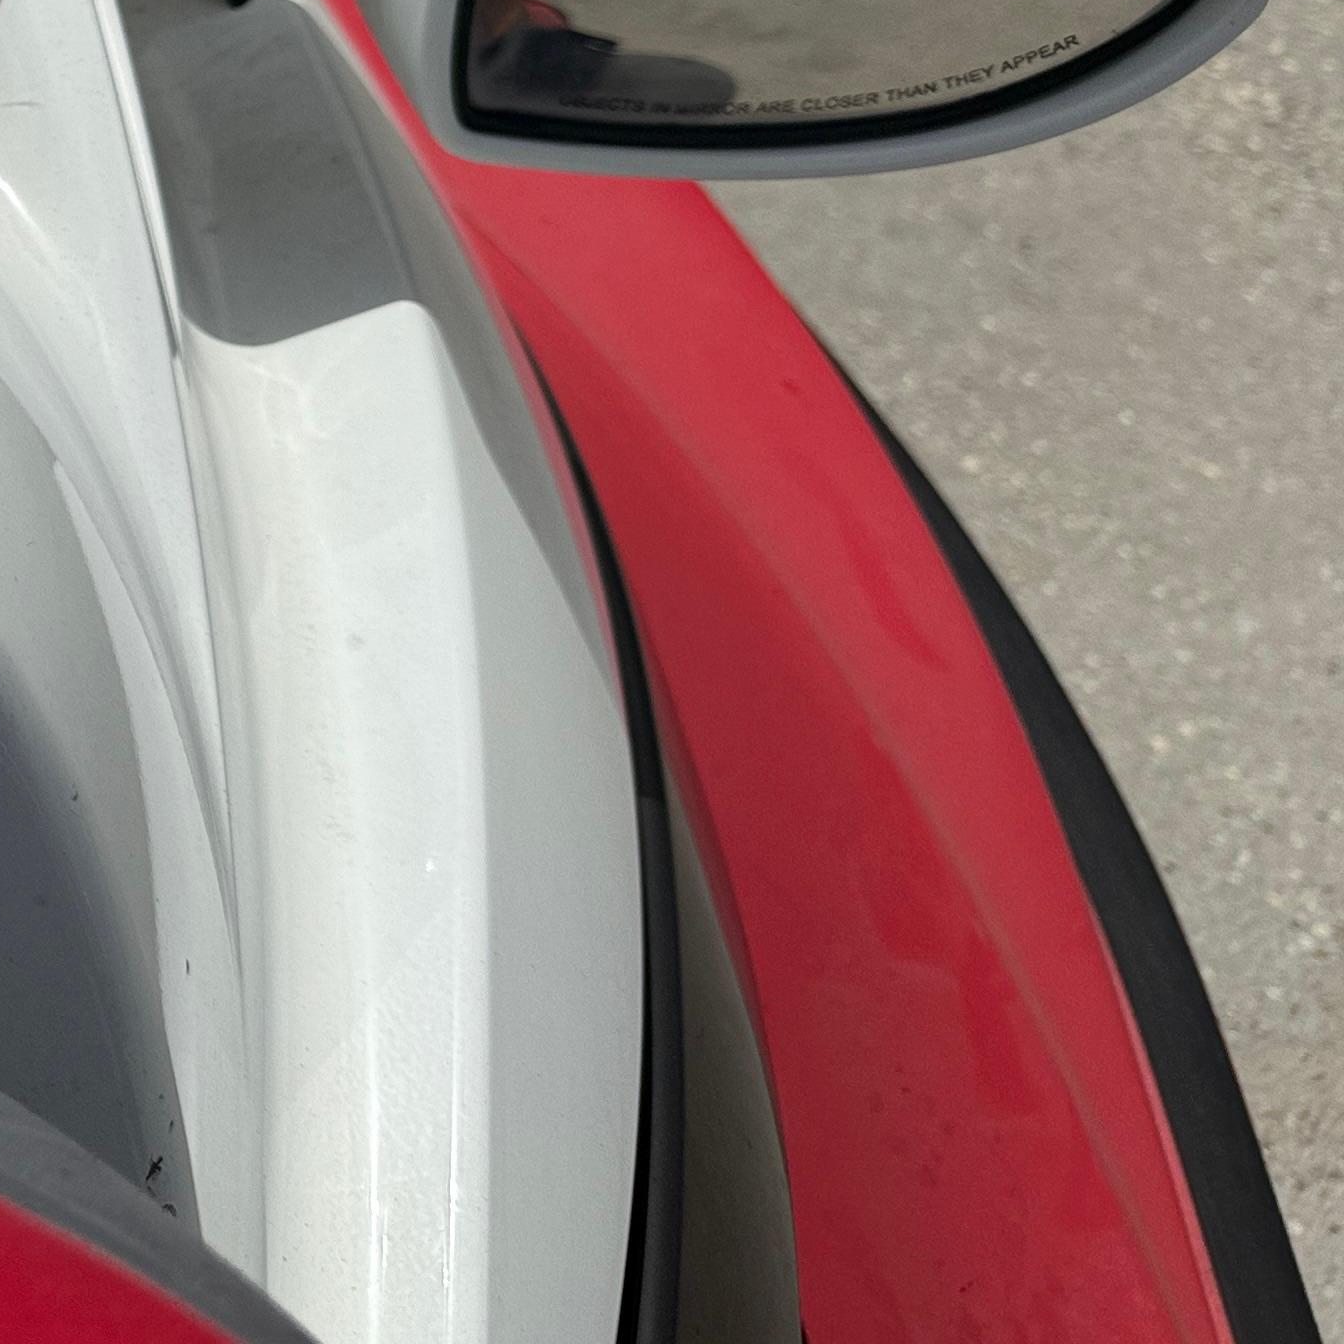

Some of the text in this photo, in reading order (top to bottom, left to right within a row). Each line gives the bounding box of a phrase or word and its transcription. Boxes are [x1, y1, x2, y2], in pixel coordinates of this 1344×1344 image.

[755, 98, 795, 114] ARE
[799, 91, 880, 112] CLOSER
[885, 80, 940, 102] THAN
[944, 64, 994, 89] THEY
[999, 33, 1081, 73] APPEAR
